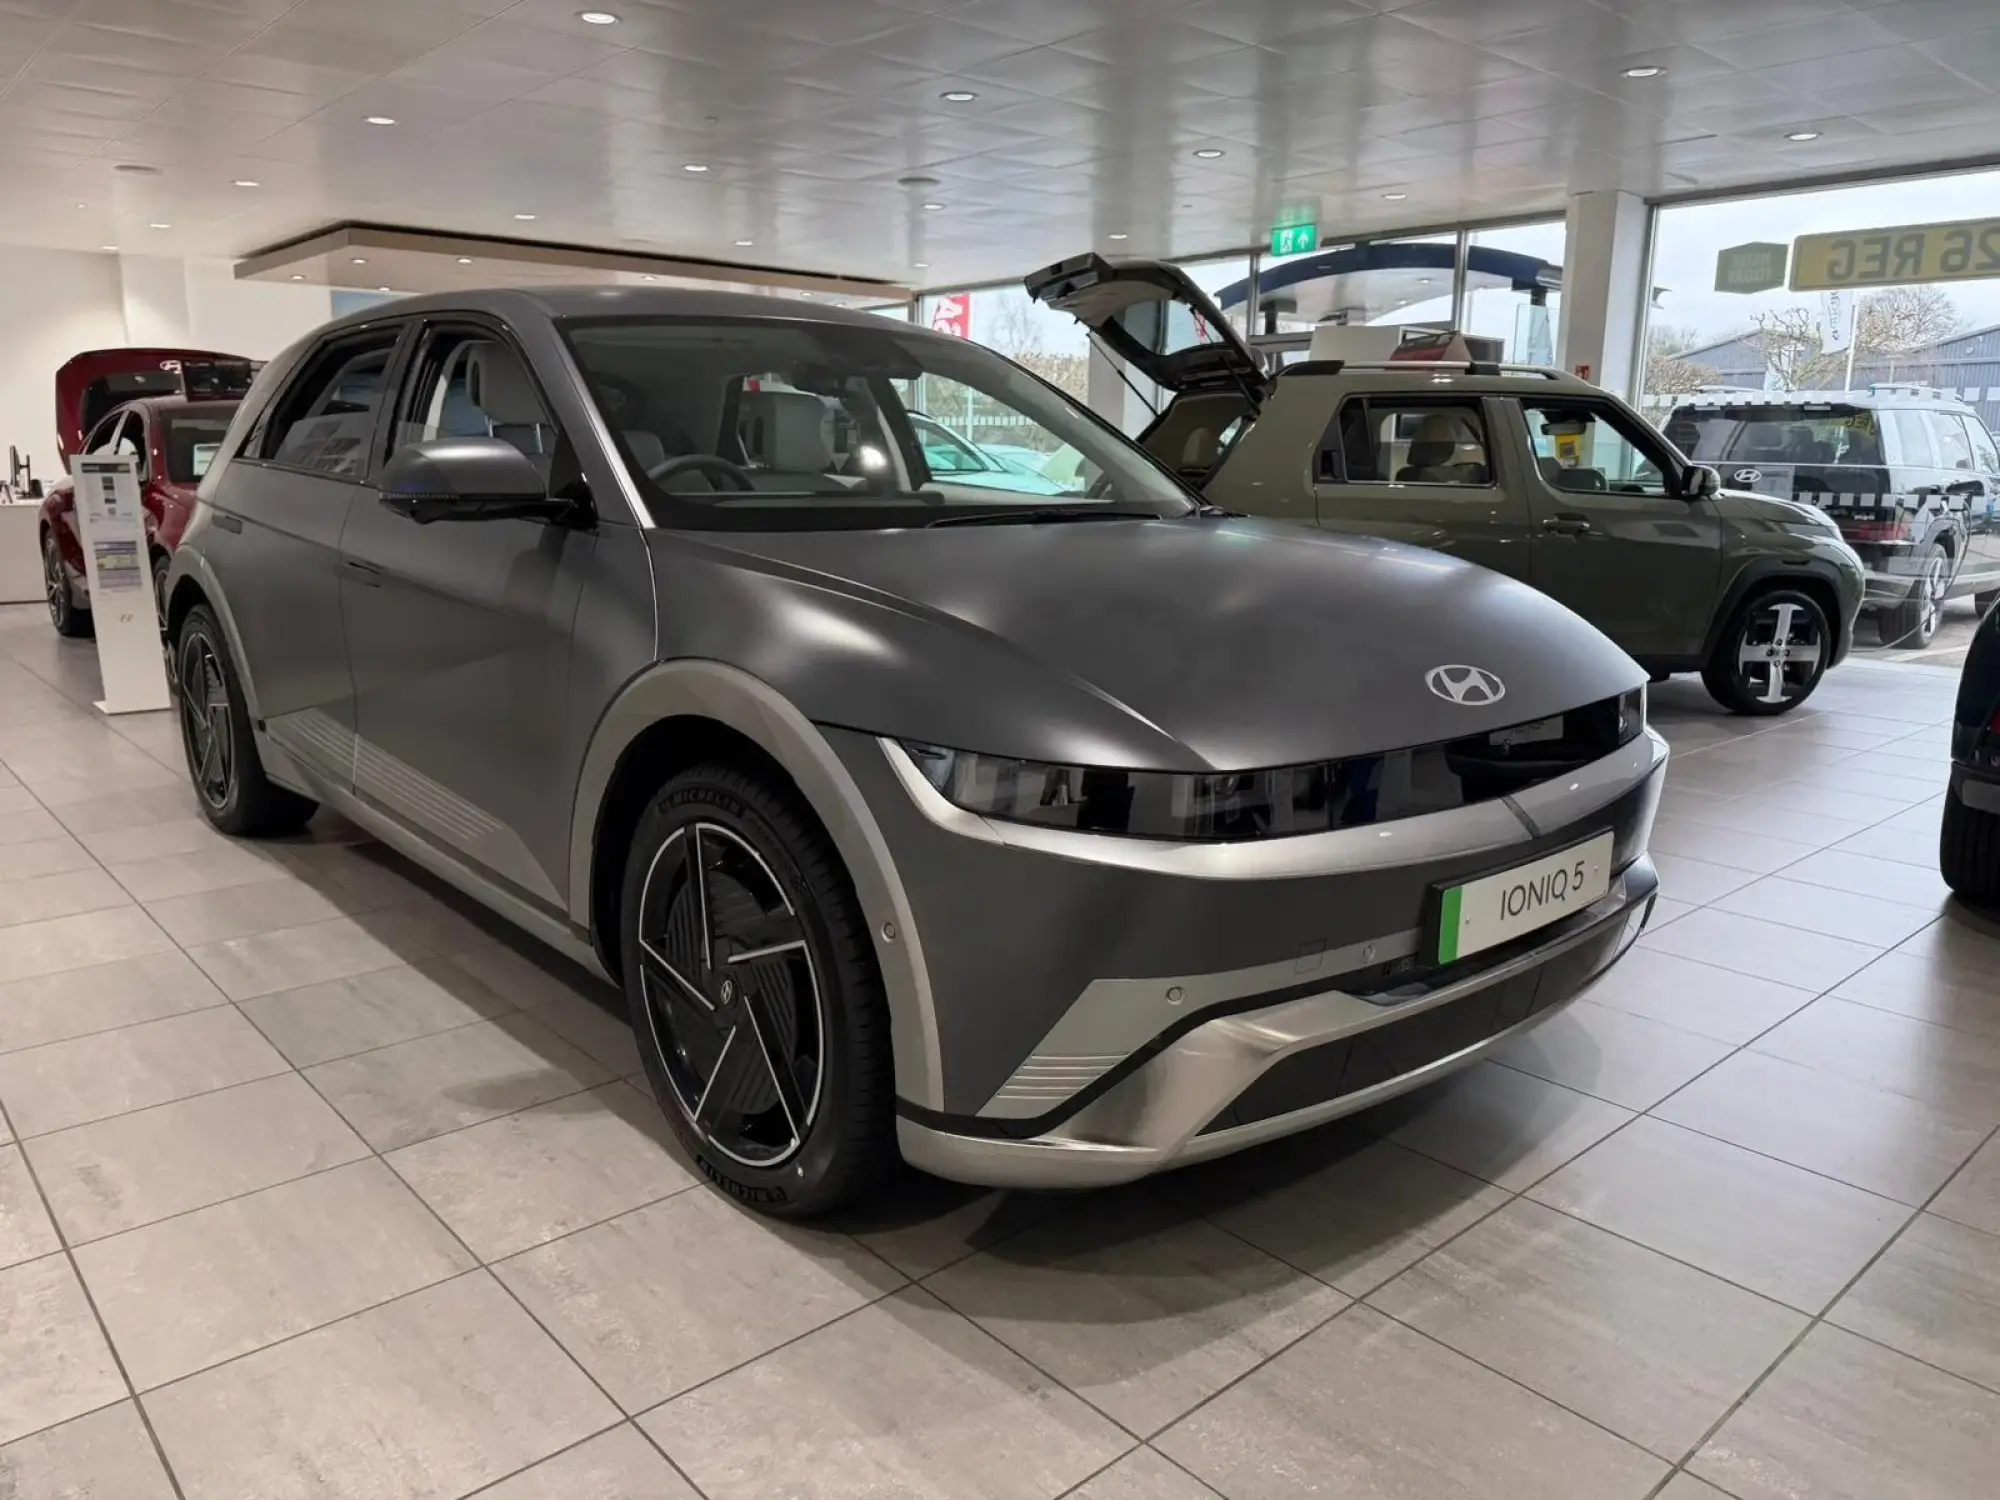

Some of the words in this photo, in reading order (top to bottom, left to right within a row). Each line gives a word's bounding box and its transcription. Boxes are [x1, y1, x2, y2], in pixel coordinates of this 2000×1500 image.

[673, 789, 742, 816] MICHELIN
[1500, 869, 1567, 920] IONIQ
[1572, 860, 1585, 891] 5
